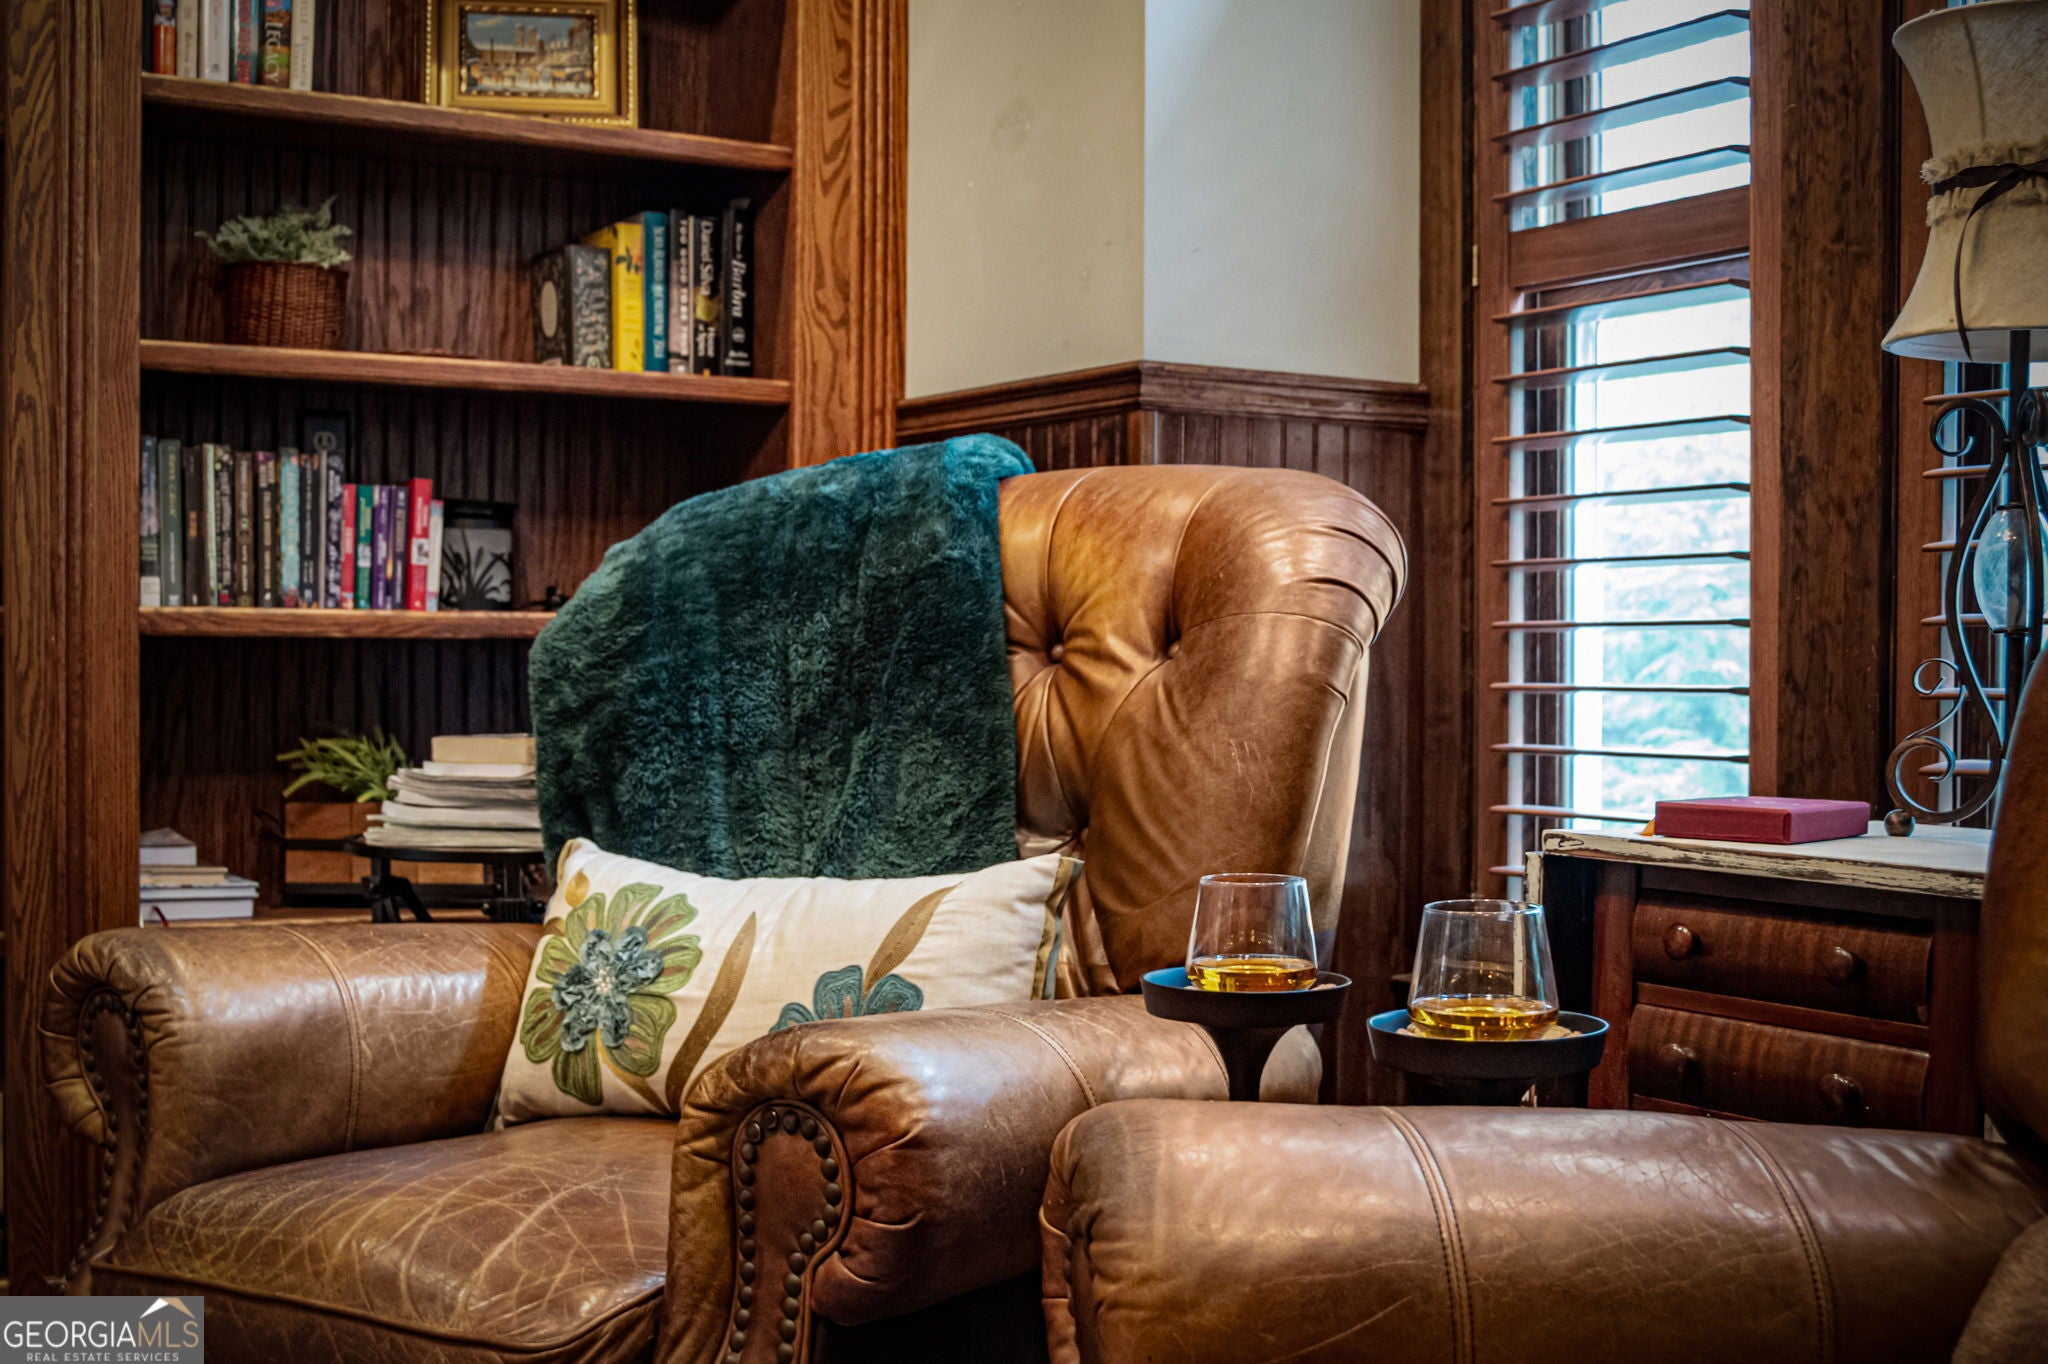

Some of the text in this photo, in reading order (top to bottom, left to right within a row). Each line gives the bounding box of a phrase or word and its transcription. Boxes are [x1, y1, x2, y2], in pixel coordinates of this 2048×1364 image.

[265, 22, 284, 84] LEGACY
[680, 219, 689, 245] TOO
[700, 220, 714, 296] Daniel Silva
[680, 247, 689, 284] GOOD
[731, 259, 747, 318] Barbra
